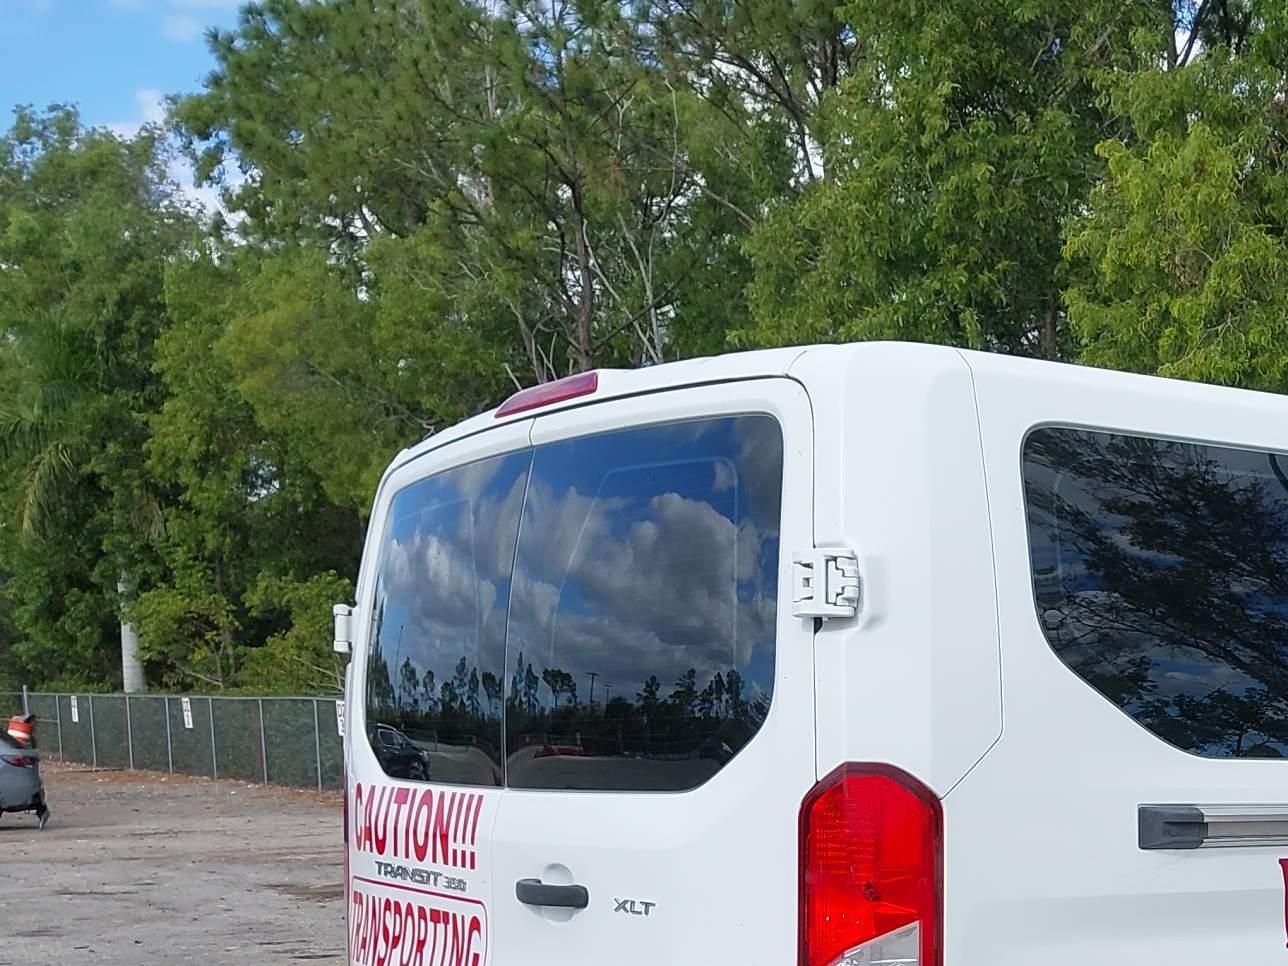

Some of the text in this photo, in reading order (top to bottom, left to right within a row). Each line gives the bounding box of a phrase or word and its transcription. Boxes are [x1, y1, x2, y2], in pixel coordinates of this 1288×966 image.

[354, 783, 484, 870] CAUTION!!!
[375, 860, 443, 887] TRANSIT
[613, 898, 656, 916] XLT
